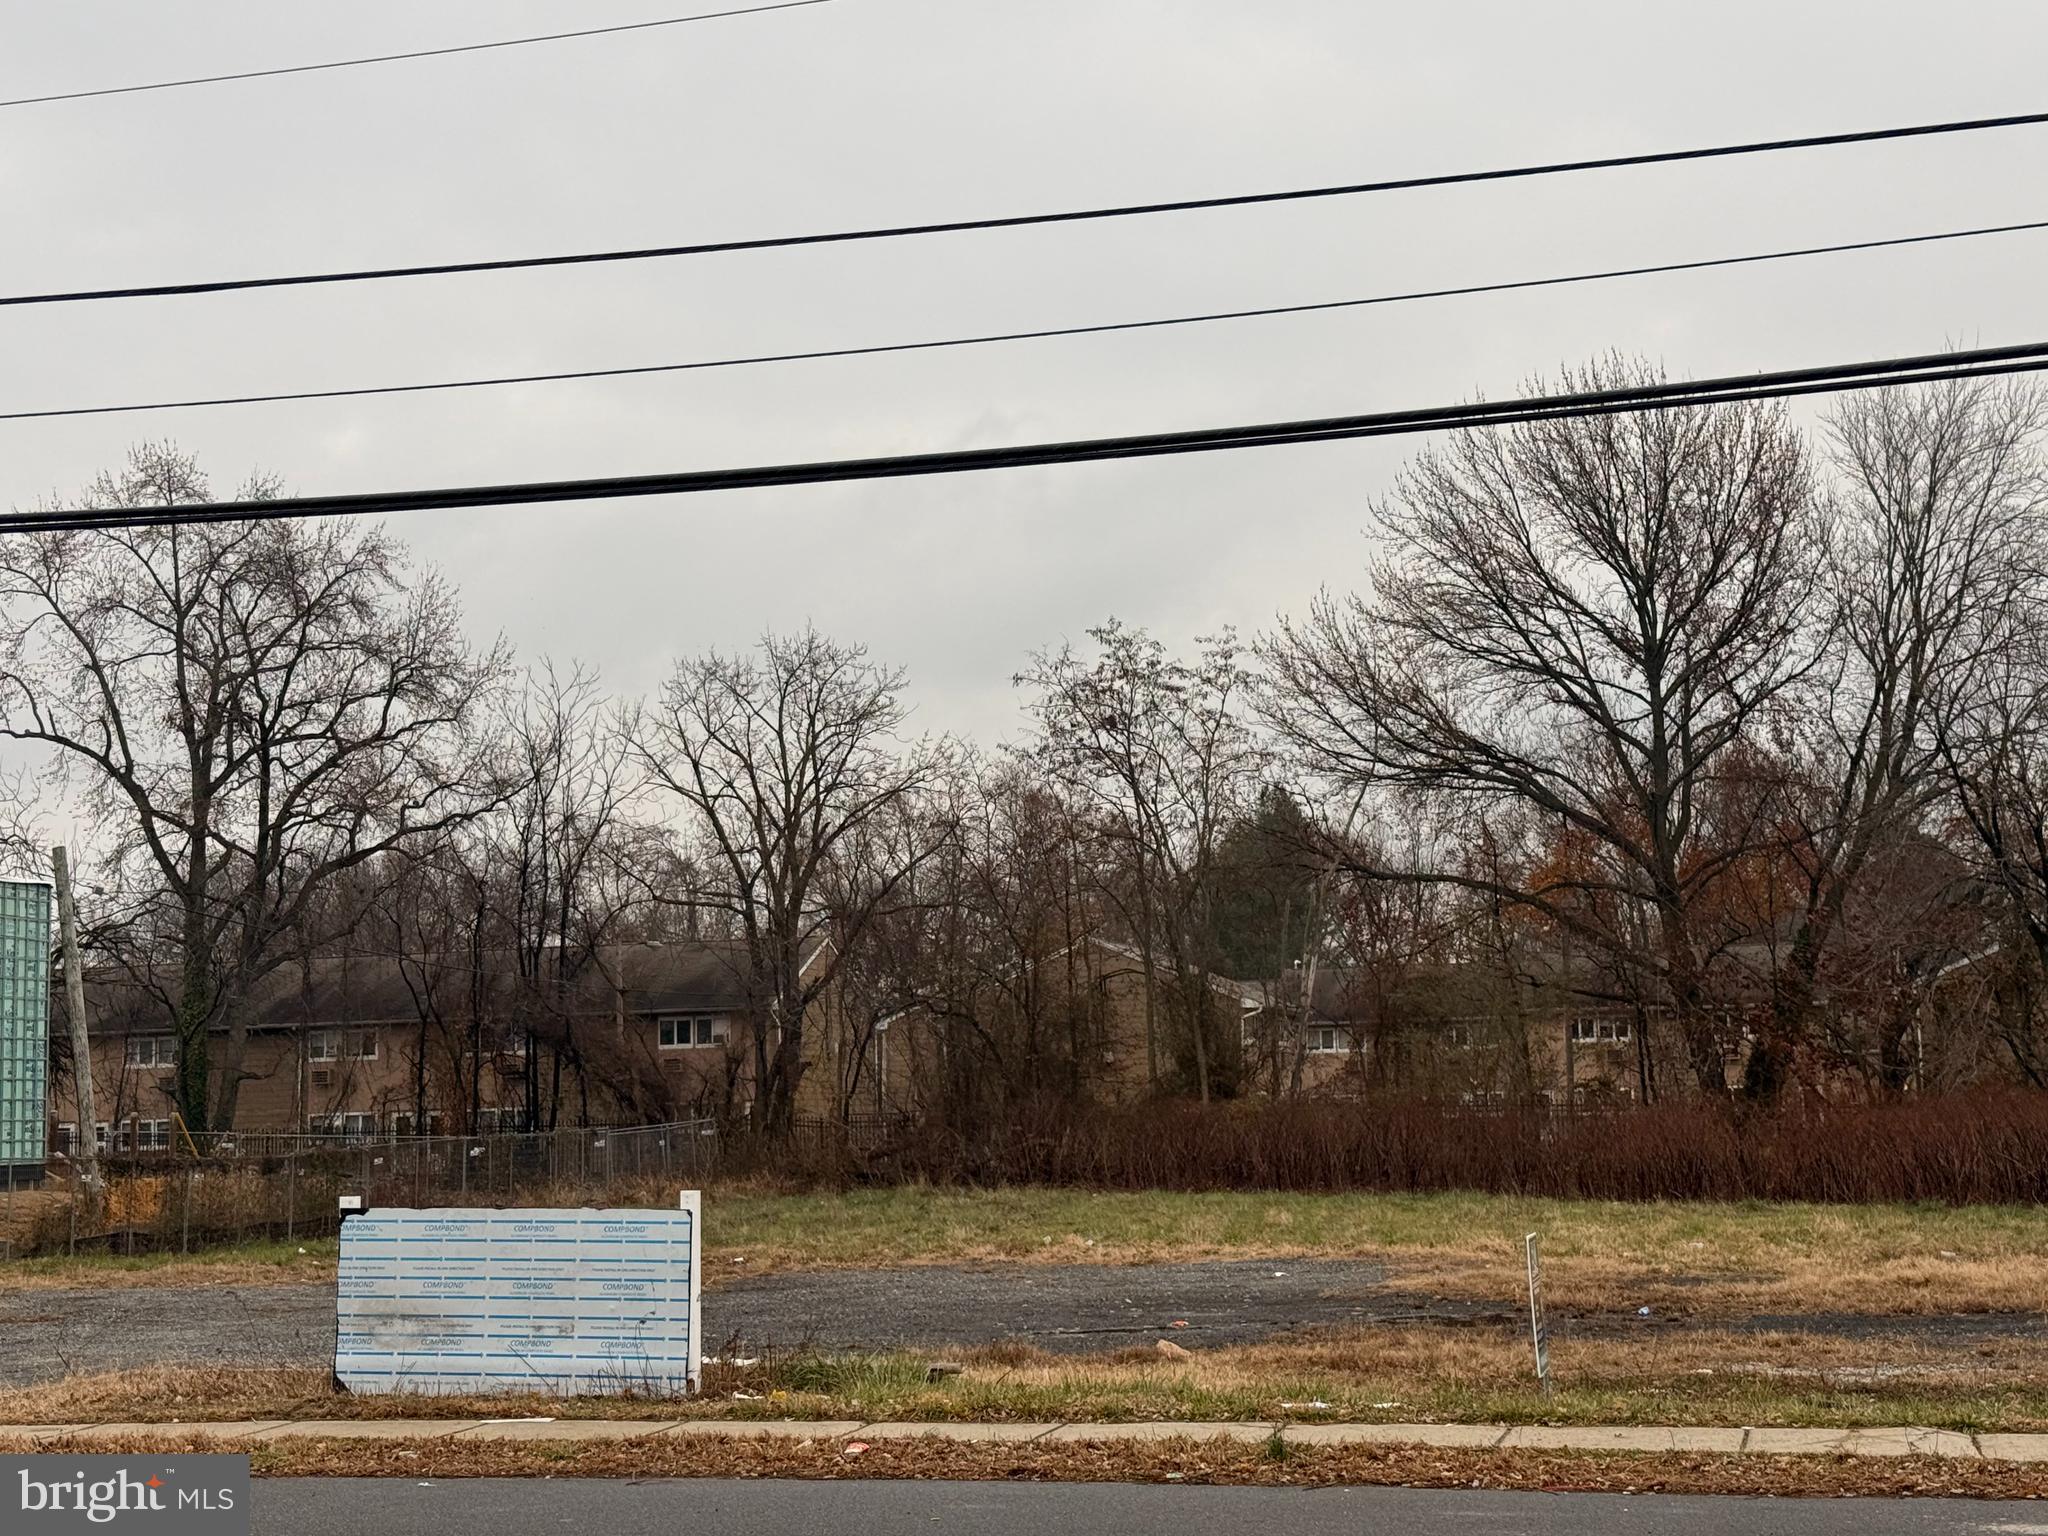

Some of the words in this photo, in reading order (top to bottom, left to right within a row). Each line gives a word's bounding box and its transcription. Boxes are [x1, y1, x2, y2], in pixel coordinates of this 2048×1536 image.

[424, 1224, 466, 1232] COMPBOND
[422, 1281, 464, 1289] COMPBOND
[512, 1282, 554, 1290] COMPBOND
[602, 1283, 645, 1291] COMPBOND
[420, 1338, 462, 1346] COMPBOND
